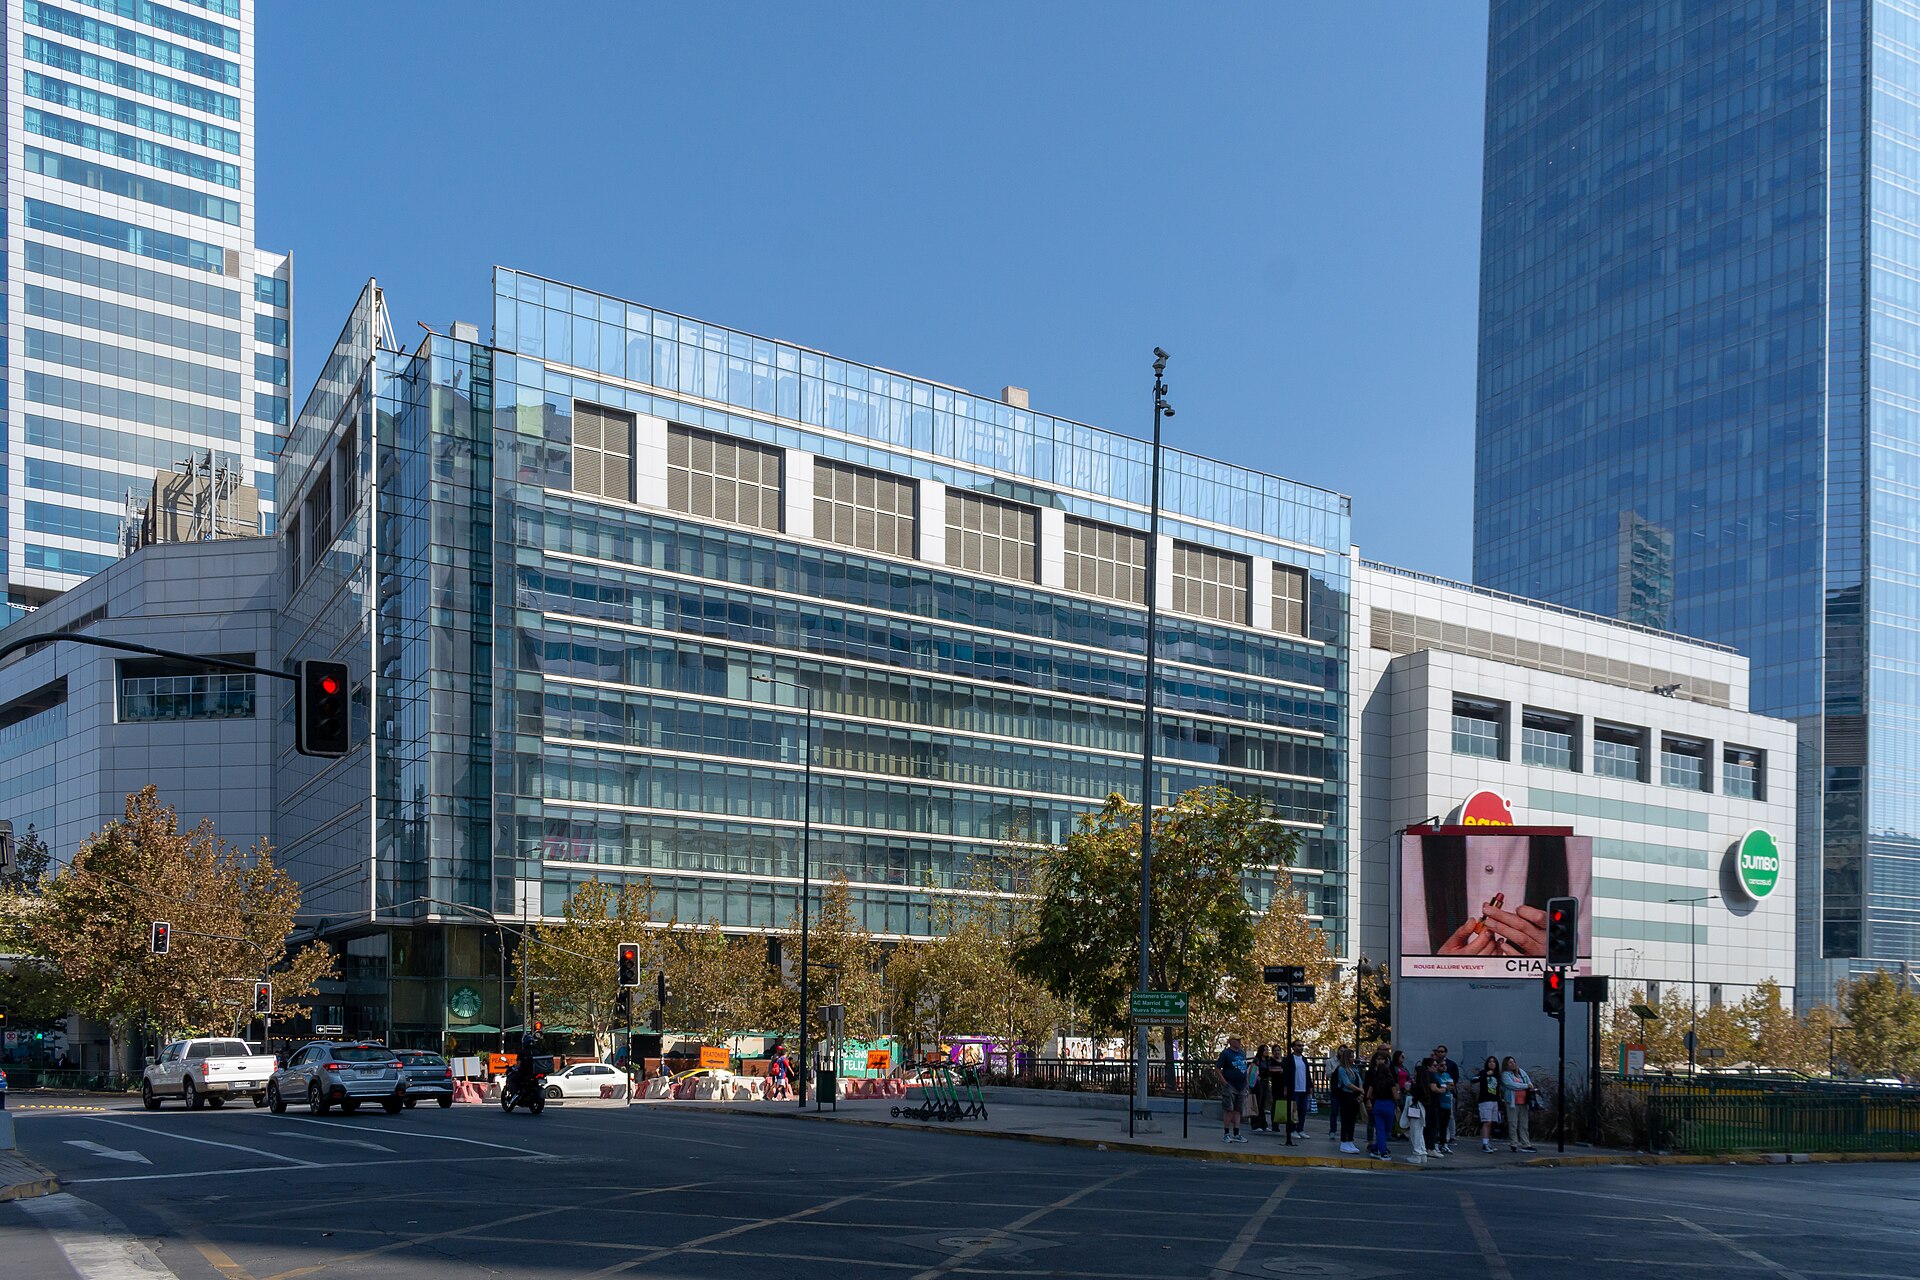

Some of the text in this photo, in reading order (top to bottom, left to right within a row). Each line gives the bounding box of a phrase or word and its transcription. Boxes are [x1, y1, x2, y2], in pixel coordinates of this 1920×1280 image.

[1742, 854, 1778, 872] JUMBO
[702, 1050, 727, 1059] PEATONES
[843, 1060, 865, 1070] FELIZ
